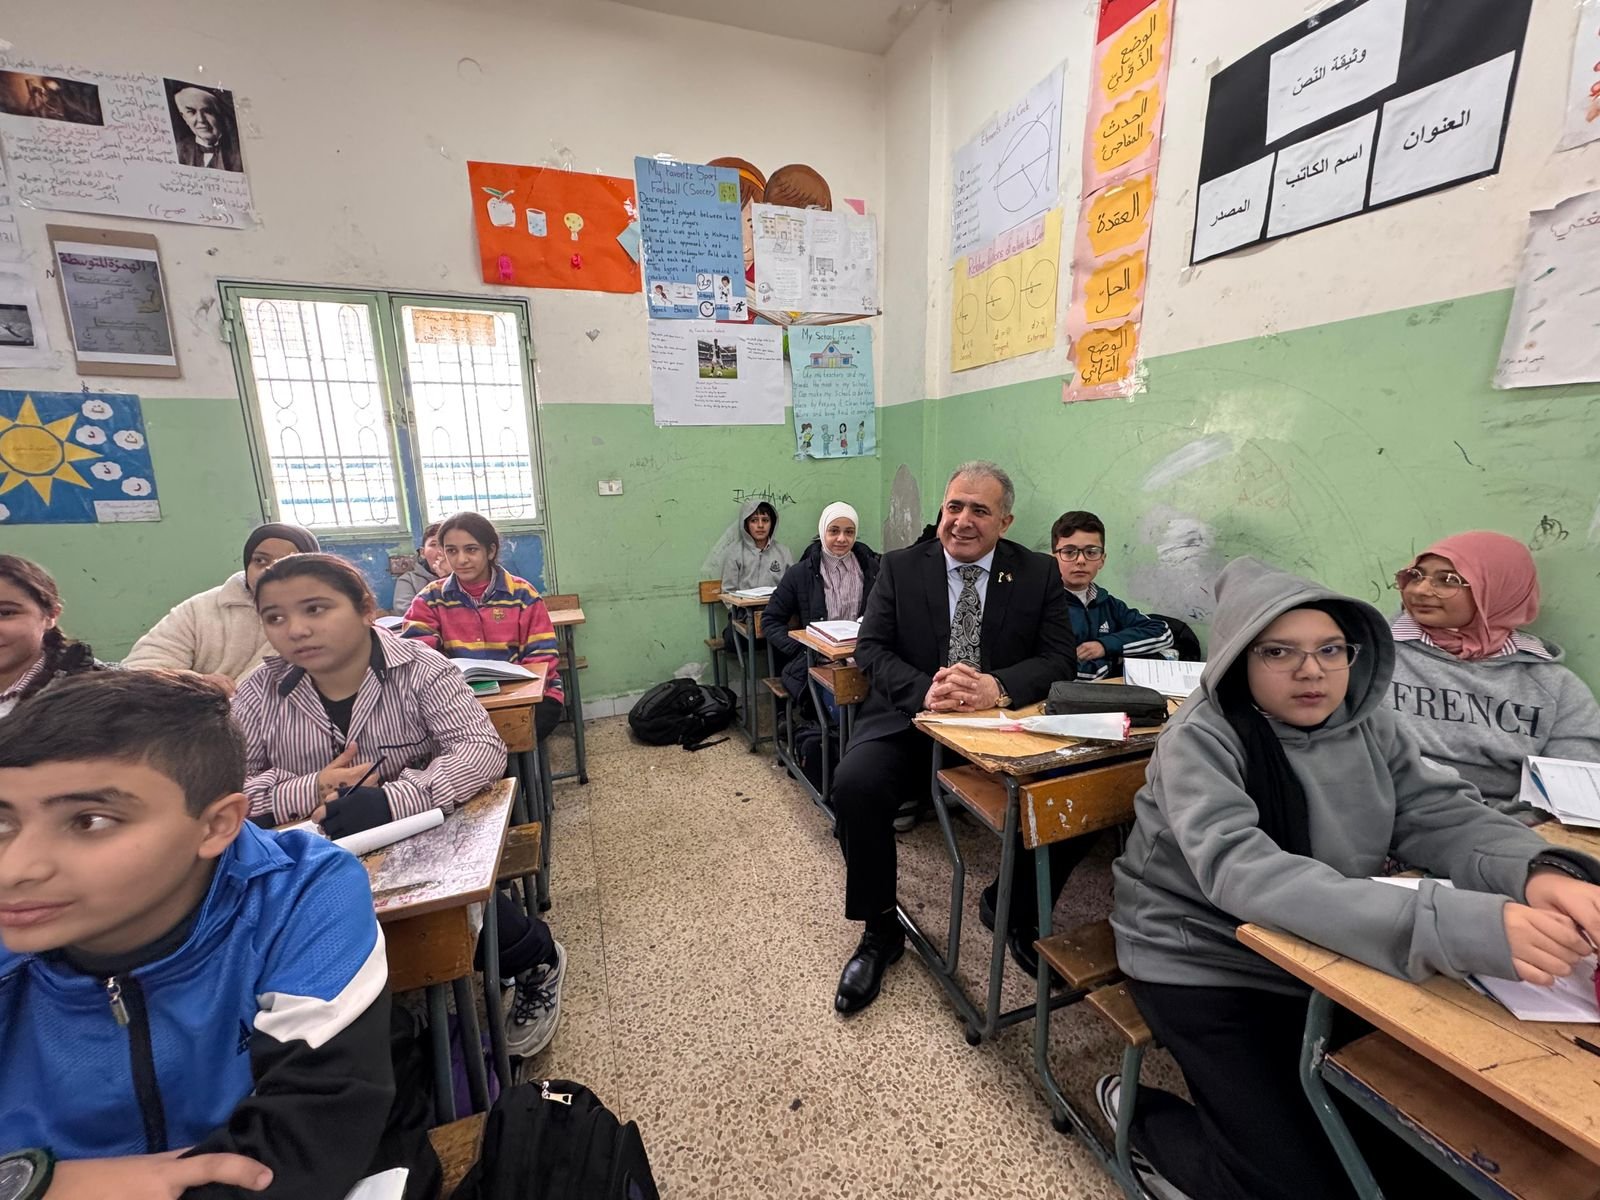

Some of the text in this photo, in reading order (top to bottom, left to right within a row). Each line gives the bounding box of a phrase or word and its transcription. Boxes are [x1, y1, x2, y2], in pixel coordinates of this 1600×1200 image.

[1120, 13, 1157, 65] الوضع
[1330, 47, 1368, 73] وثيقة
[1102, 96, 1148, 139] الحدث
[1402, 108, 1471, 151] العنوان
[647, 159, 663, 183] My
[1285, 157, 1329, 188] الكاتب
[678, 207, 696, 219] played
[700, 210, 723, 220] between
[1096, 191, 1140, 234] العقدة
[1209, 198, 1251, 227] المصدر
[801, 328, 813, 344] My
[815, 327, 835, 341] School
[1087, 328, 1128, 364] الوضع
[1391, 680, 1544, 739] FRENCH
